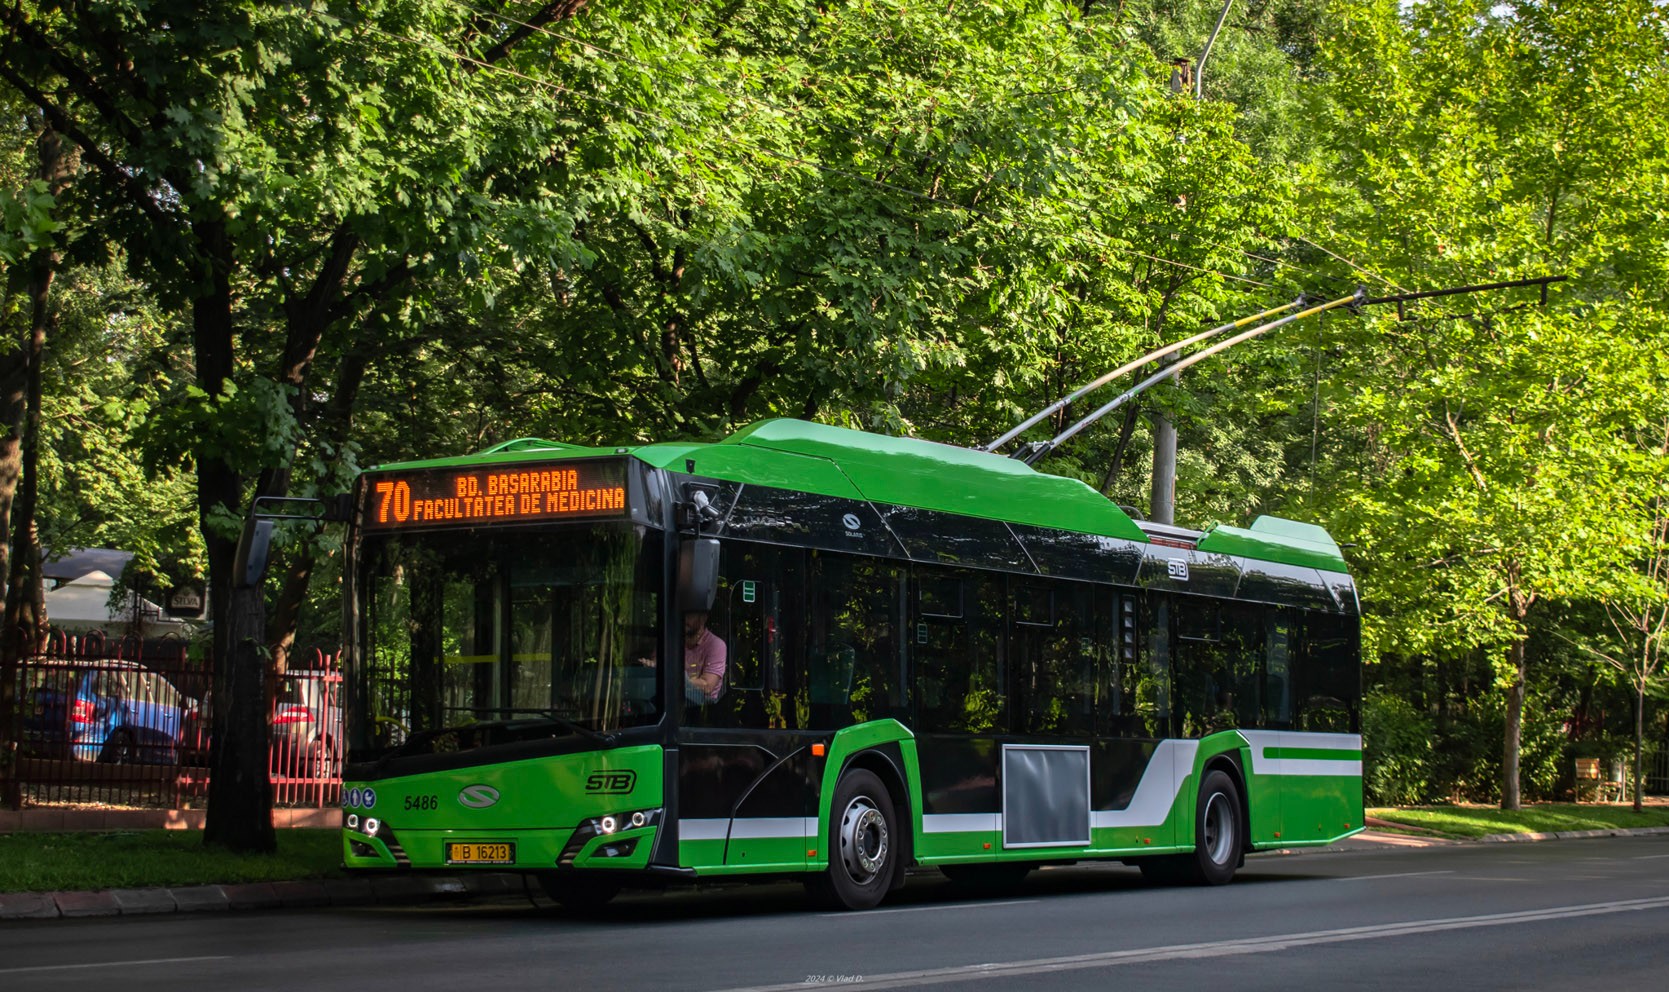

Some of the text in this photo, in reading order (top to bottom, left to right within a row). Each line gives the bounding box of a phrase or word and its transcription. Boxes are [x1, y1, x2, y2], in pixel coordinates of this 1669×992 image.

[457, 469, 578, 498] BD. BASARABIA
[376, 481, 410, 523] 70
[413, 487, 625, 521] FACULTATEA DE MEDICINA
[1168, 560, 1187, 578] STB
[173, 595, 199, 607] SILVA
[585, 772, 633, 791] STB
[404, 795, 438, 810] 5486
[462, 845, 507, 859] B 16213
